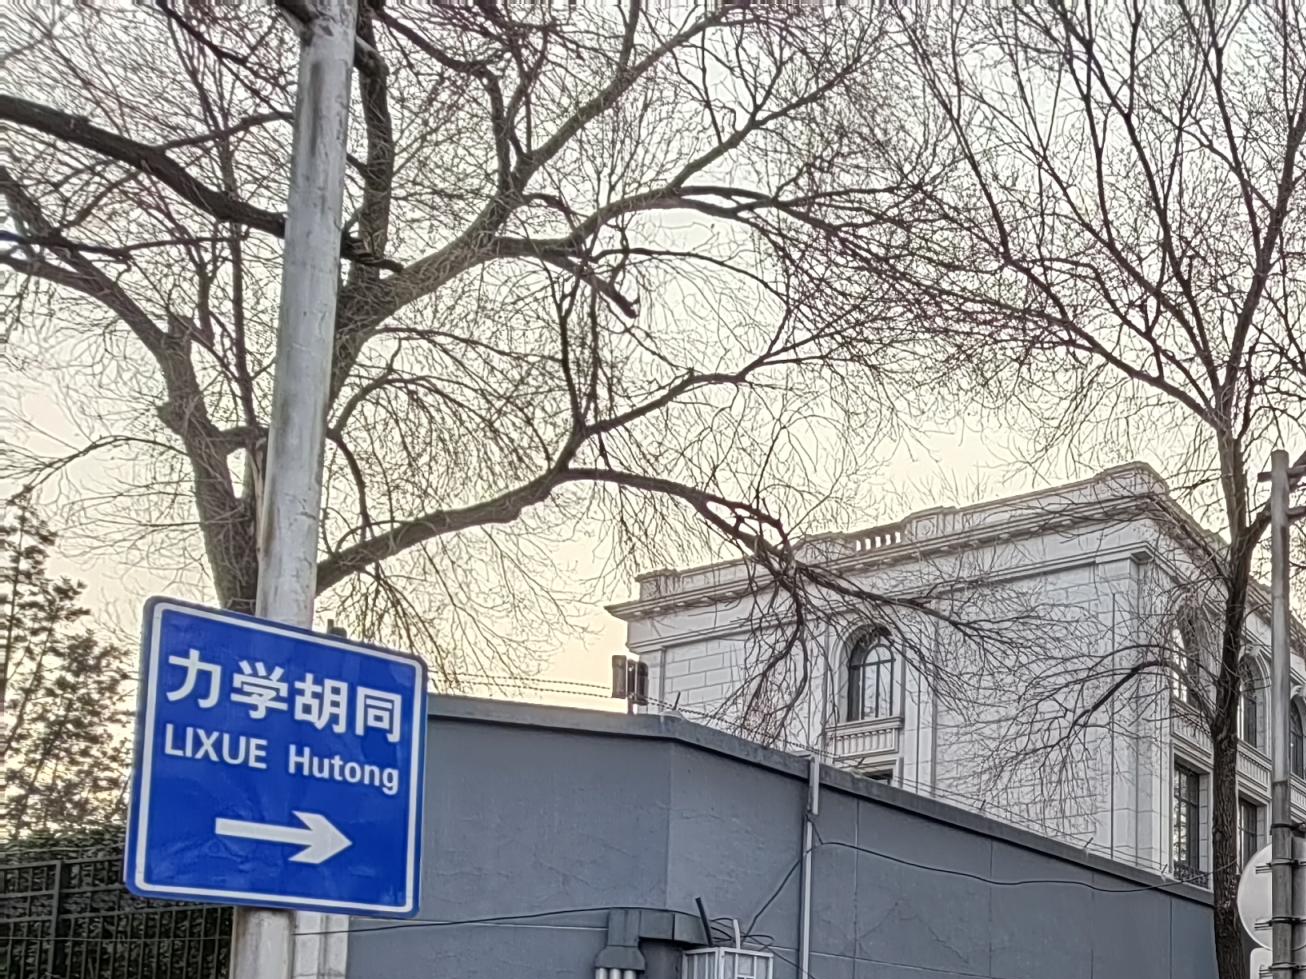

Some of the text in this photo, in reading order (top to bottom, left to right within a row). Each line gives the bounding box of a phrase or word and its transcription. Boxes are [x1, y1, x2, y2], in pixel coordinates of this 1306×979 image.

[167, 648, 402, 743] 力学胡同
[164, 723, 399, 795] LIXUE Hutong
